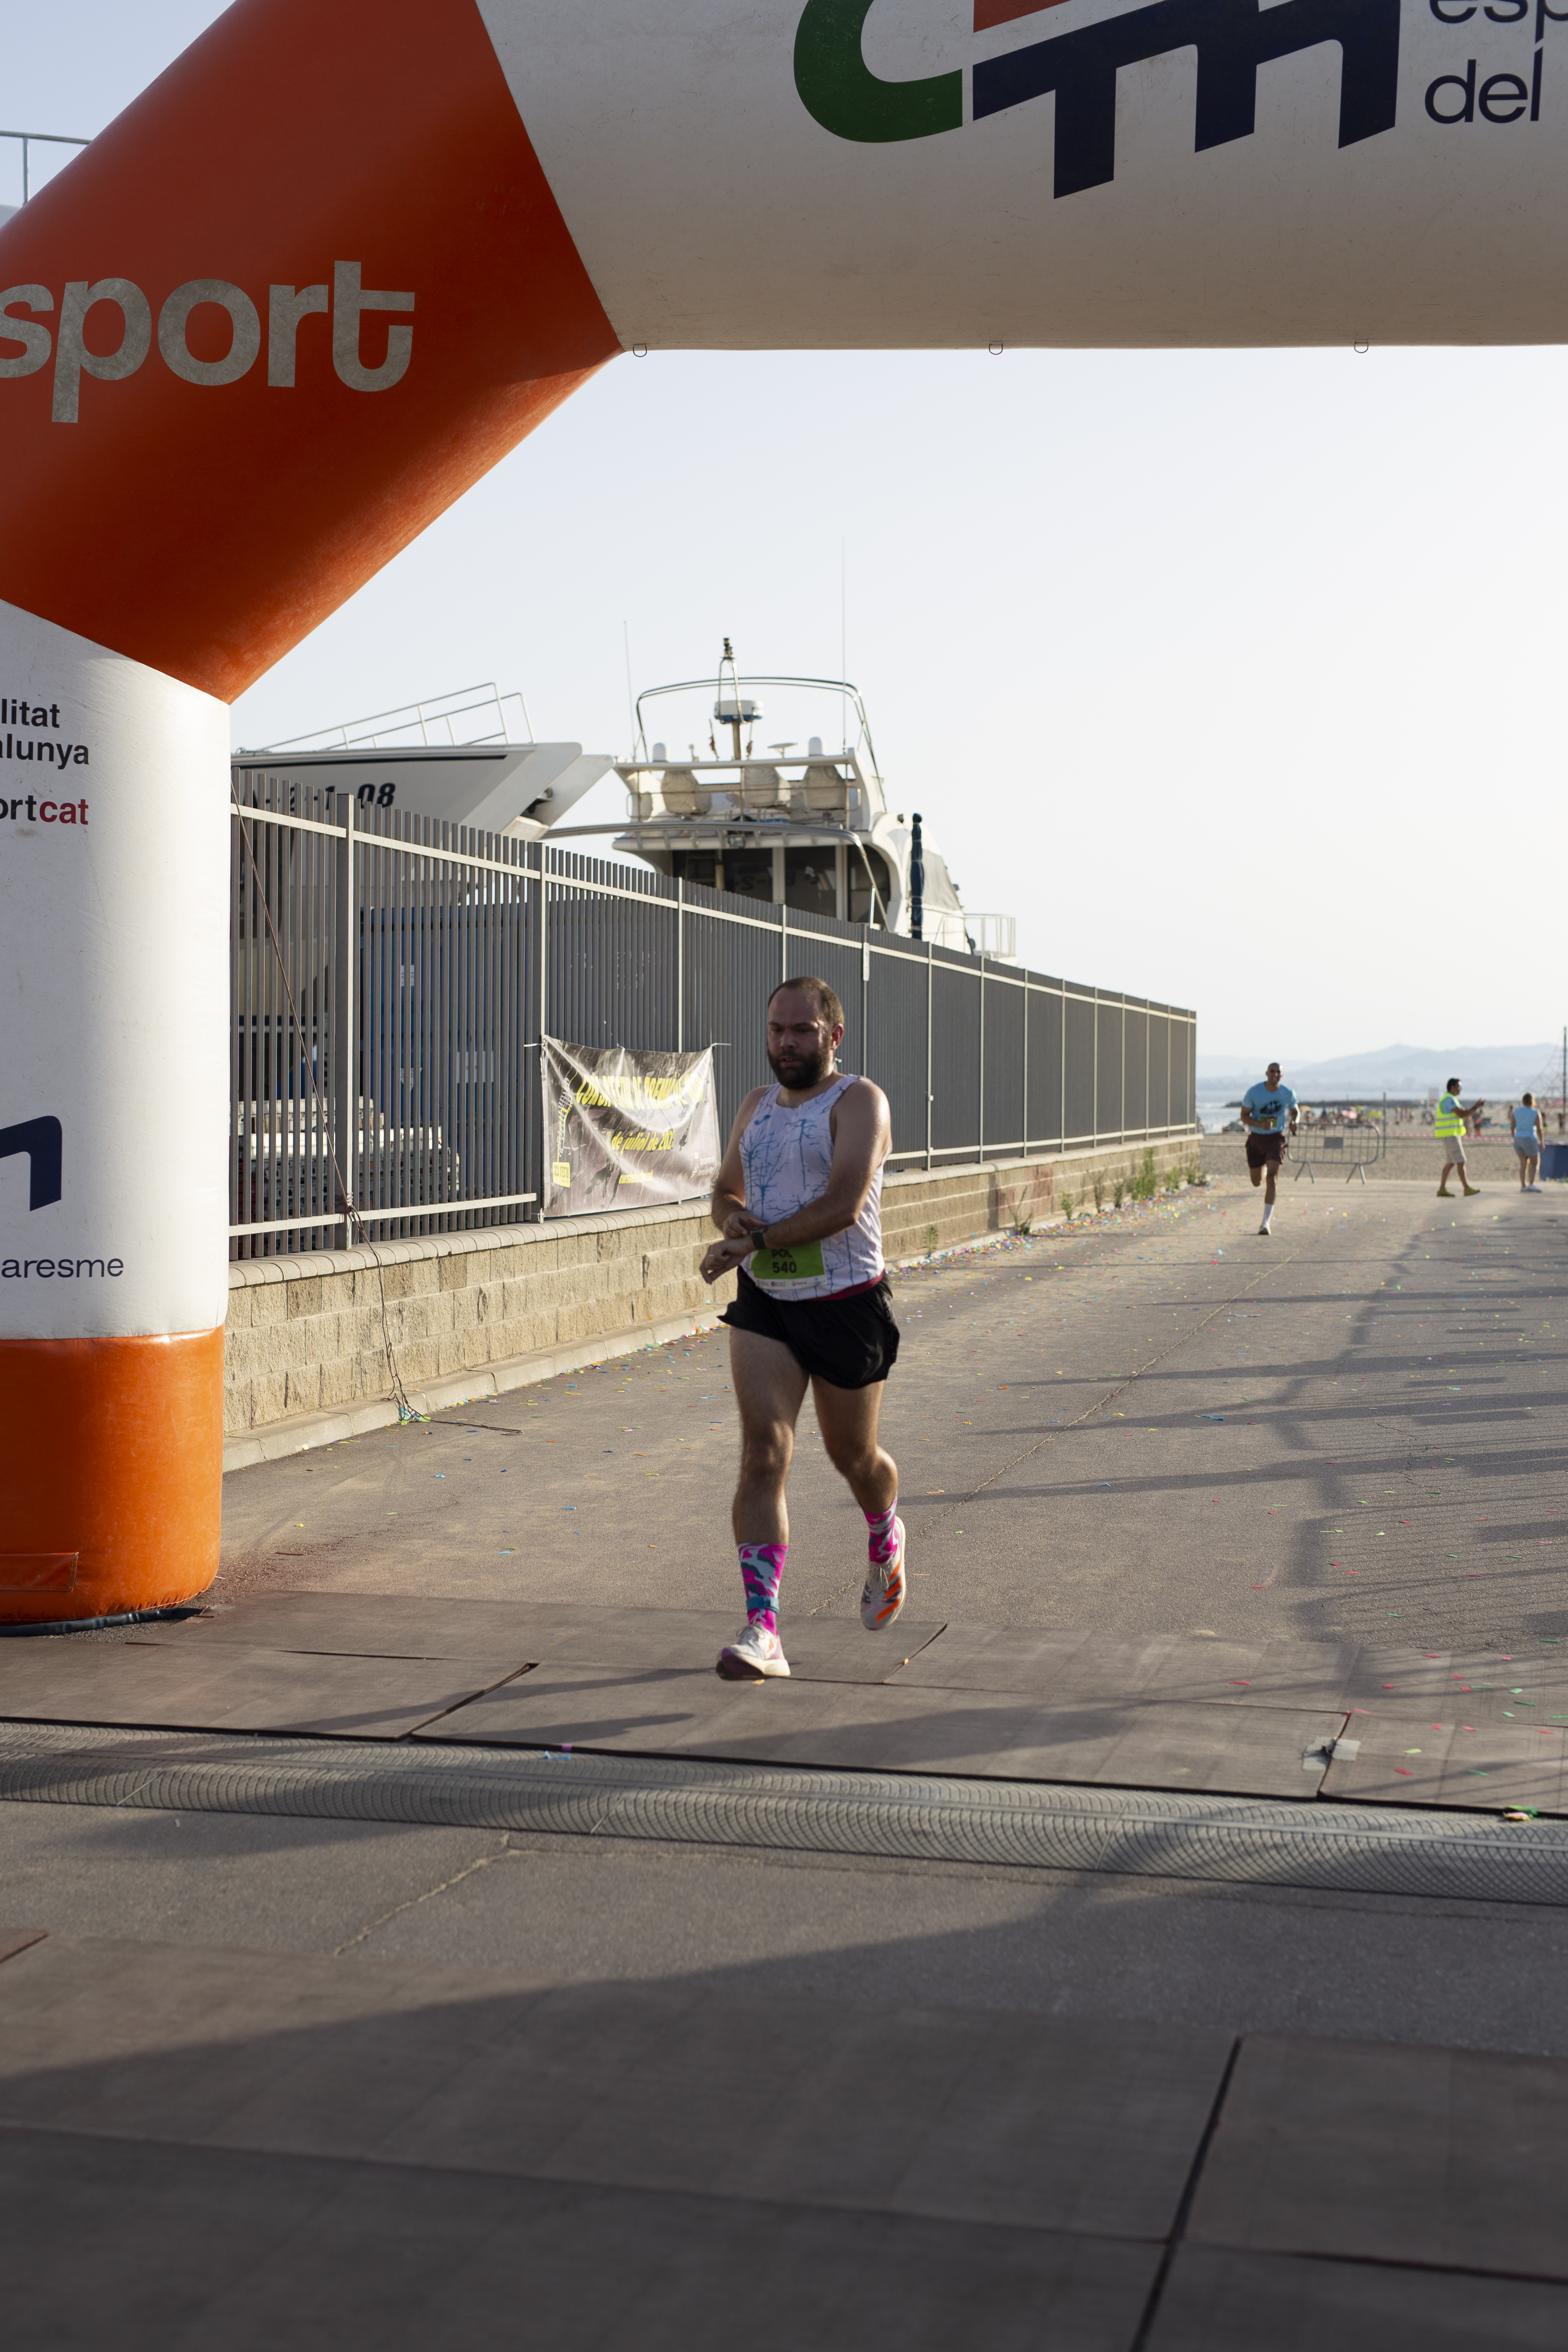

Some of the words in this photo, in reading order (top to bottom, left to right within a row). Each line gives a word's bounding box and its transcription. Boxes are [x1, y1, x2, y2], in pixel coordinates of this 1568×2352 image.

[1424, 46, 1544, 124] del
[0, 260, 415, 423] sport
[1, 698, 60, 728] litat
[612, 1131, 623, 1151] de
[620, 1132, 650, 1156] juliol
[647, 1132, 659, 1151] de
[771, 1248, 793, 1258] POL
[1, 1258, 124, 1278] aresme
[772, 1261, 797, 1274] 540
